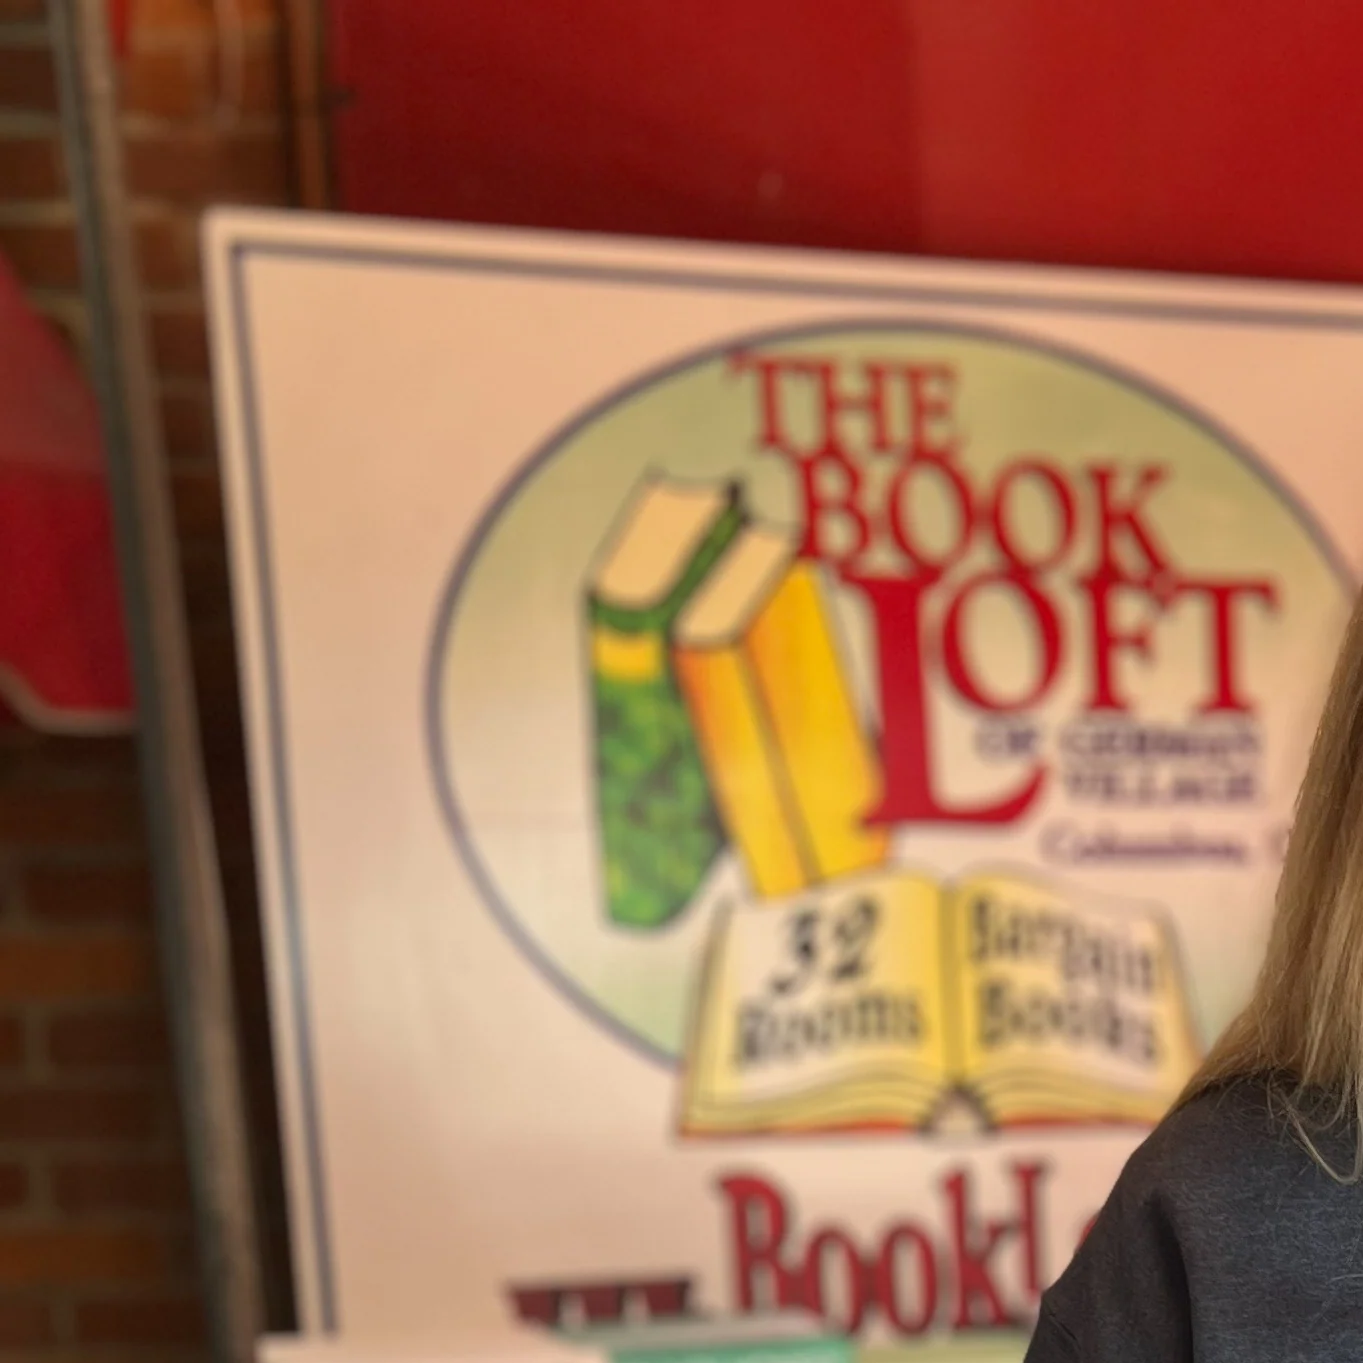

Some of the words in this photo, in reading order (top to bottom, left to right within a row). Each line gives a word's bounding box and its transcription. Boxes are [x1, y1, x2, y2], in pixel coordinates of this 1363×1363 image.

[730, 353, 966, 463] THE
[786, 446, 1172, 580] BOOK
[837, 560, 1281, 830] LOFT
[977, 718, 1042, 761] OF
[737, 992, 928, 1070] Rooms
[976, 975, 1161, 1068] Books
